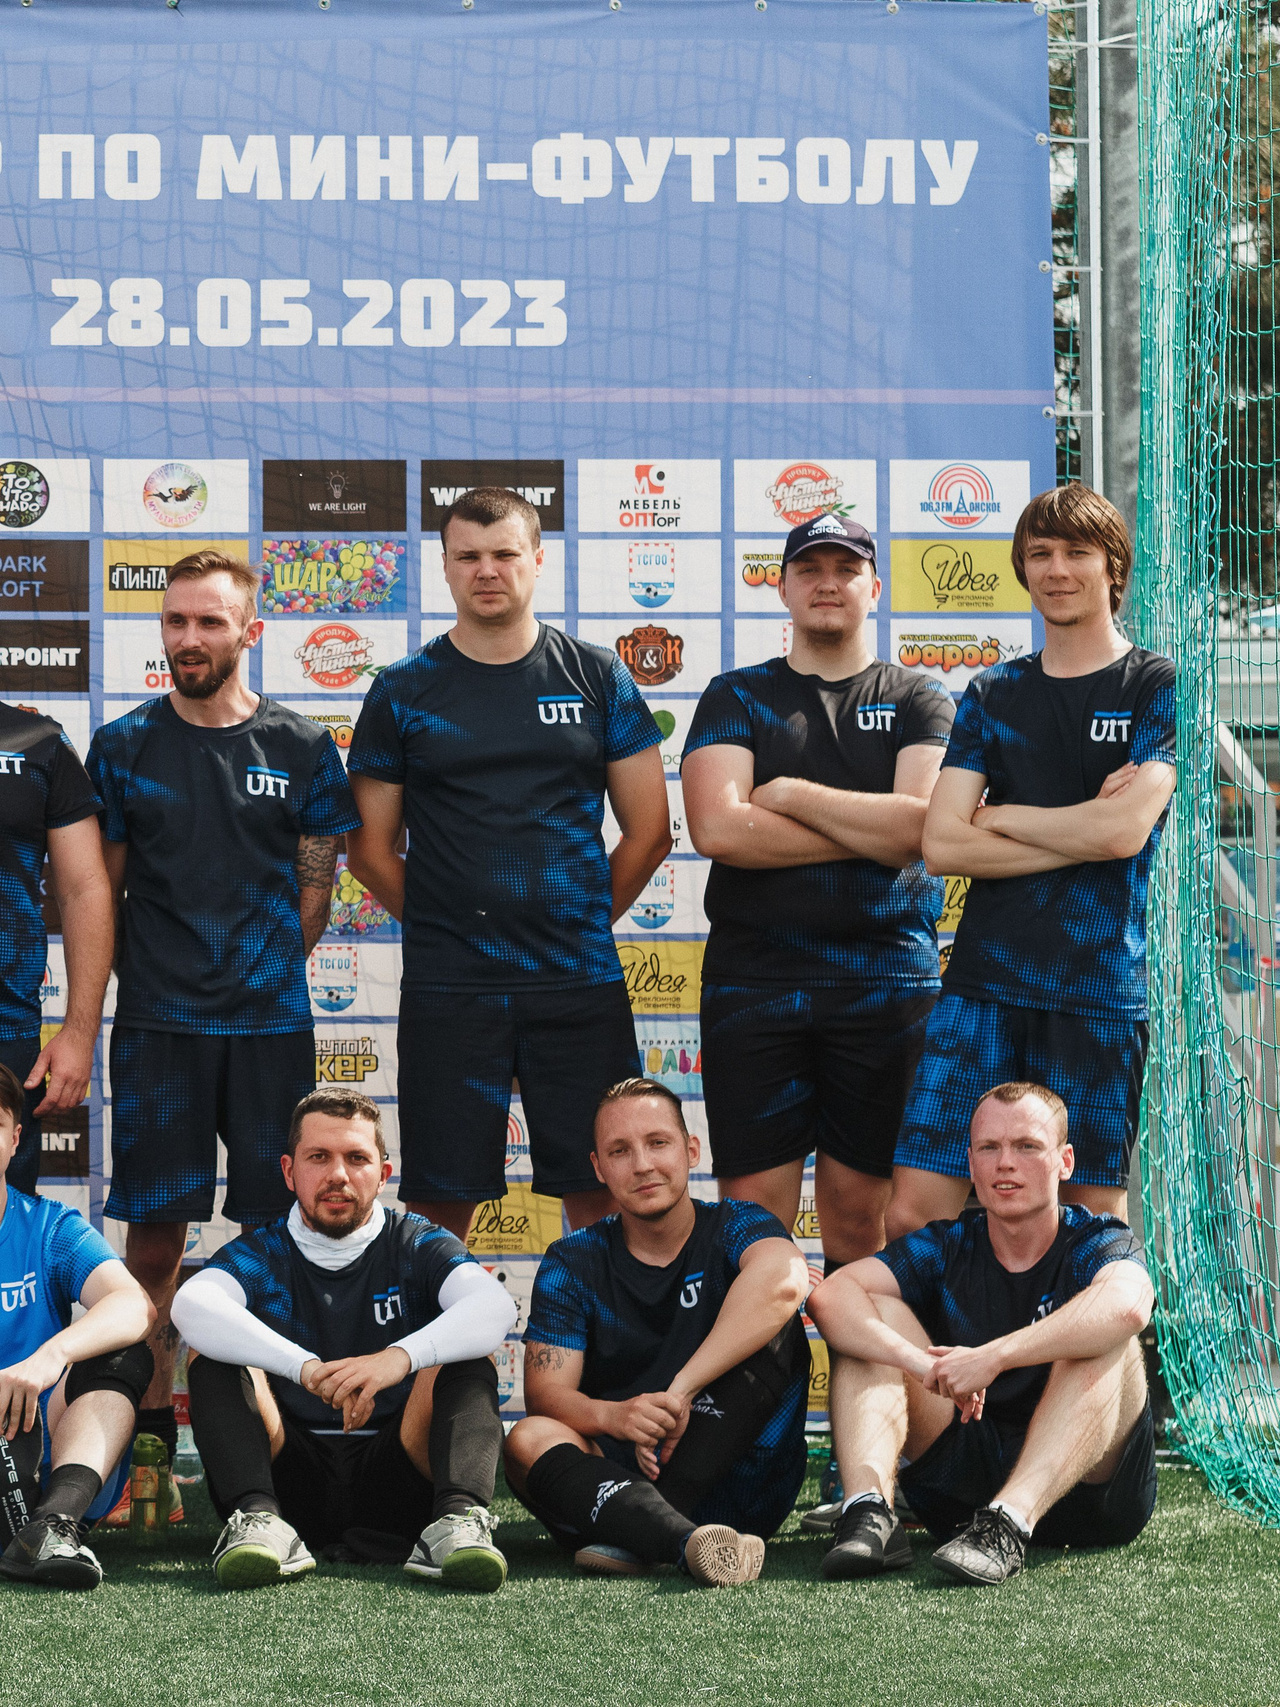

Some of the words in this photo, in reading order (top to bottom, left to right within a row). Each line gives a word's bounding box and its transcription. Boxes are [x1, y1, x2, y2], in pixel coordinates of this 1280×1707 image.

[38, 133, 161, 200] ПО
[196, 132, 978, 205] МИНИ-ФУТБОЛУ
[50, 279, 568, 347] 28.05.2023
[3, 474, 30, 489] ТО
[786, 467, 822, 481] ПРОДУКТ
[0, 501, 40, 512] НАДО
[309, 503, 322, 511] WE
[324, 503, 340, 511] ARE
[342, 503, 366, 511] LIGHT
[619, 500, 680, 509] МЕБЕЛЬ
[808, 525, 848, 537] adidas
[637, 554, 667, 565] ТСГОО
[274, 560, 337, 592] ШАР
[315, 628, 351, 641] ПРОДУКТ
[294, 637, 374, 664] Чистая
[303, 653, 372, 678] Линия
[538, 703, 583, 724] UIT
[857, 711, 896, 732] UIT
[1090, 719, 1131, 742] UIT
[246, 774, 290, 799] UIT
[319, 958, 350, 970] ТСГОО
[0, 1435, 19, 1483] ELITE
[591, 1479, 632, 1523] DEMIX
